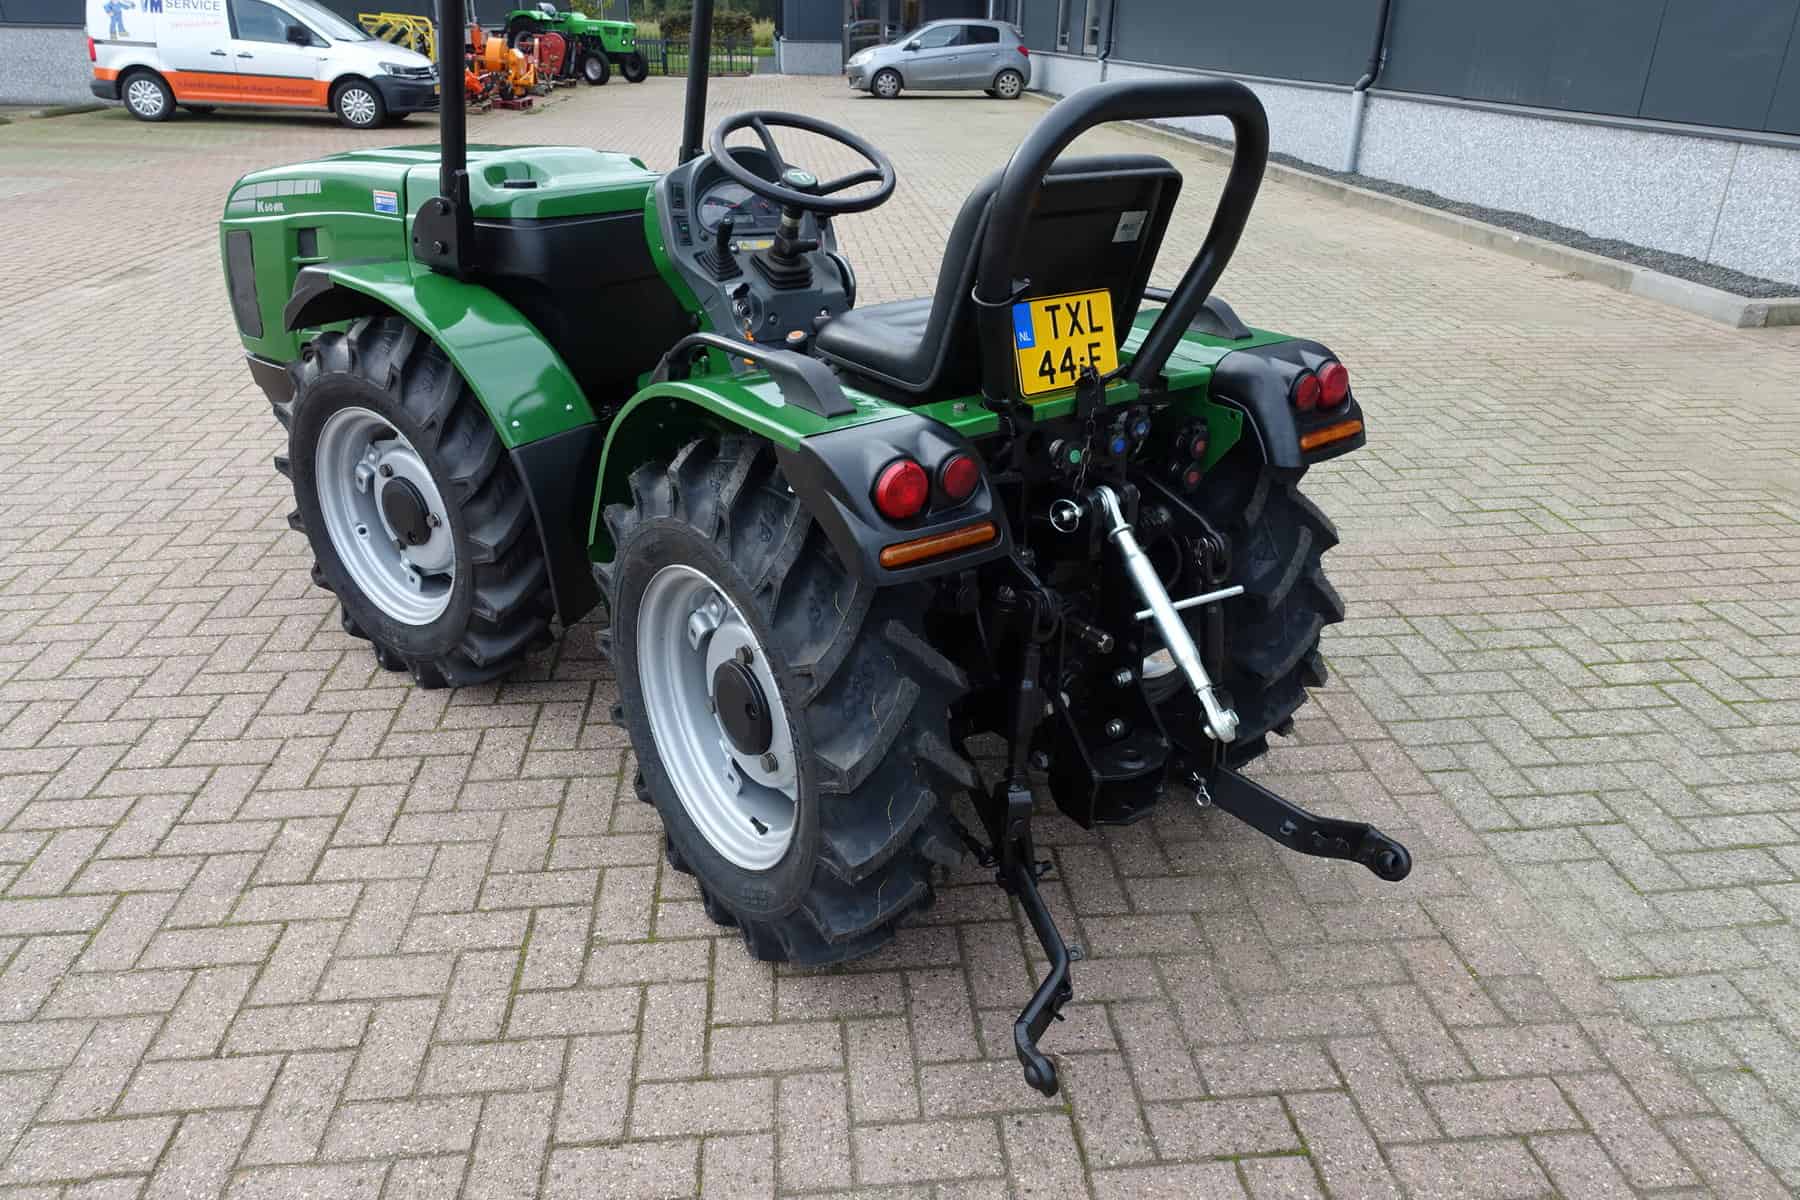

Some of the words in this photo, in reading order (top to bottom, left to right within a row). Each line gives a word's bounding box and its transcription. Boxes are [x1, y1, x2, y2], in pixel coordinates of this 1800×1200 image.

[166, 0, 221, 11] SERVICE
[1044, 299, 1104, 340] TXL
[1018, 331, 1032, 343] NL
